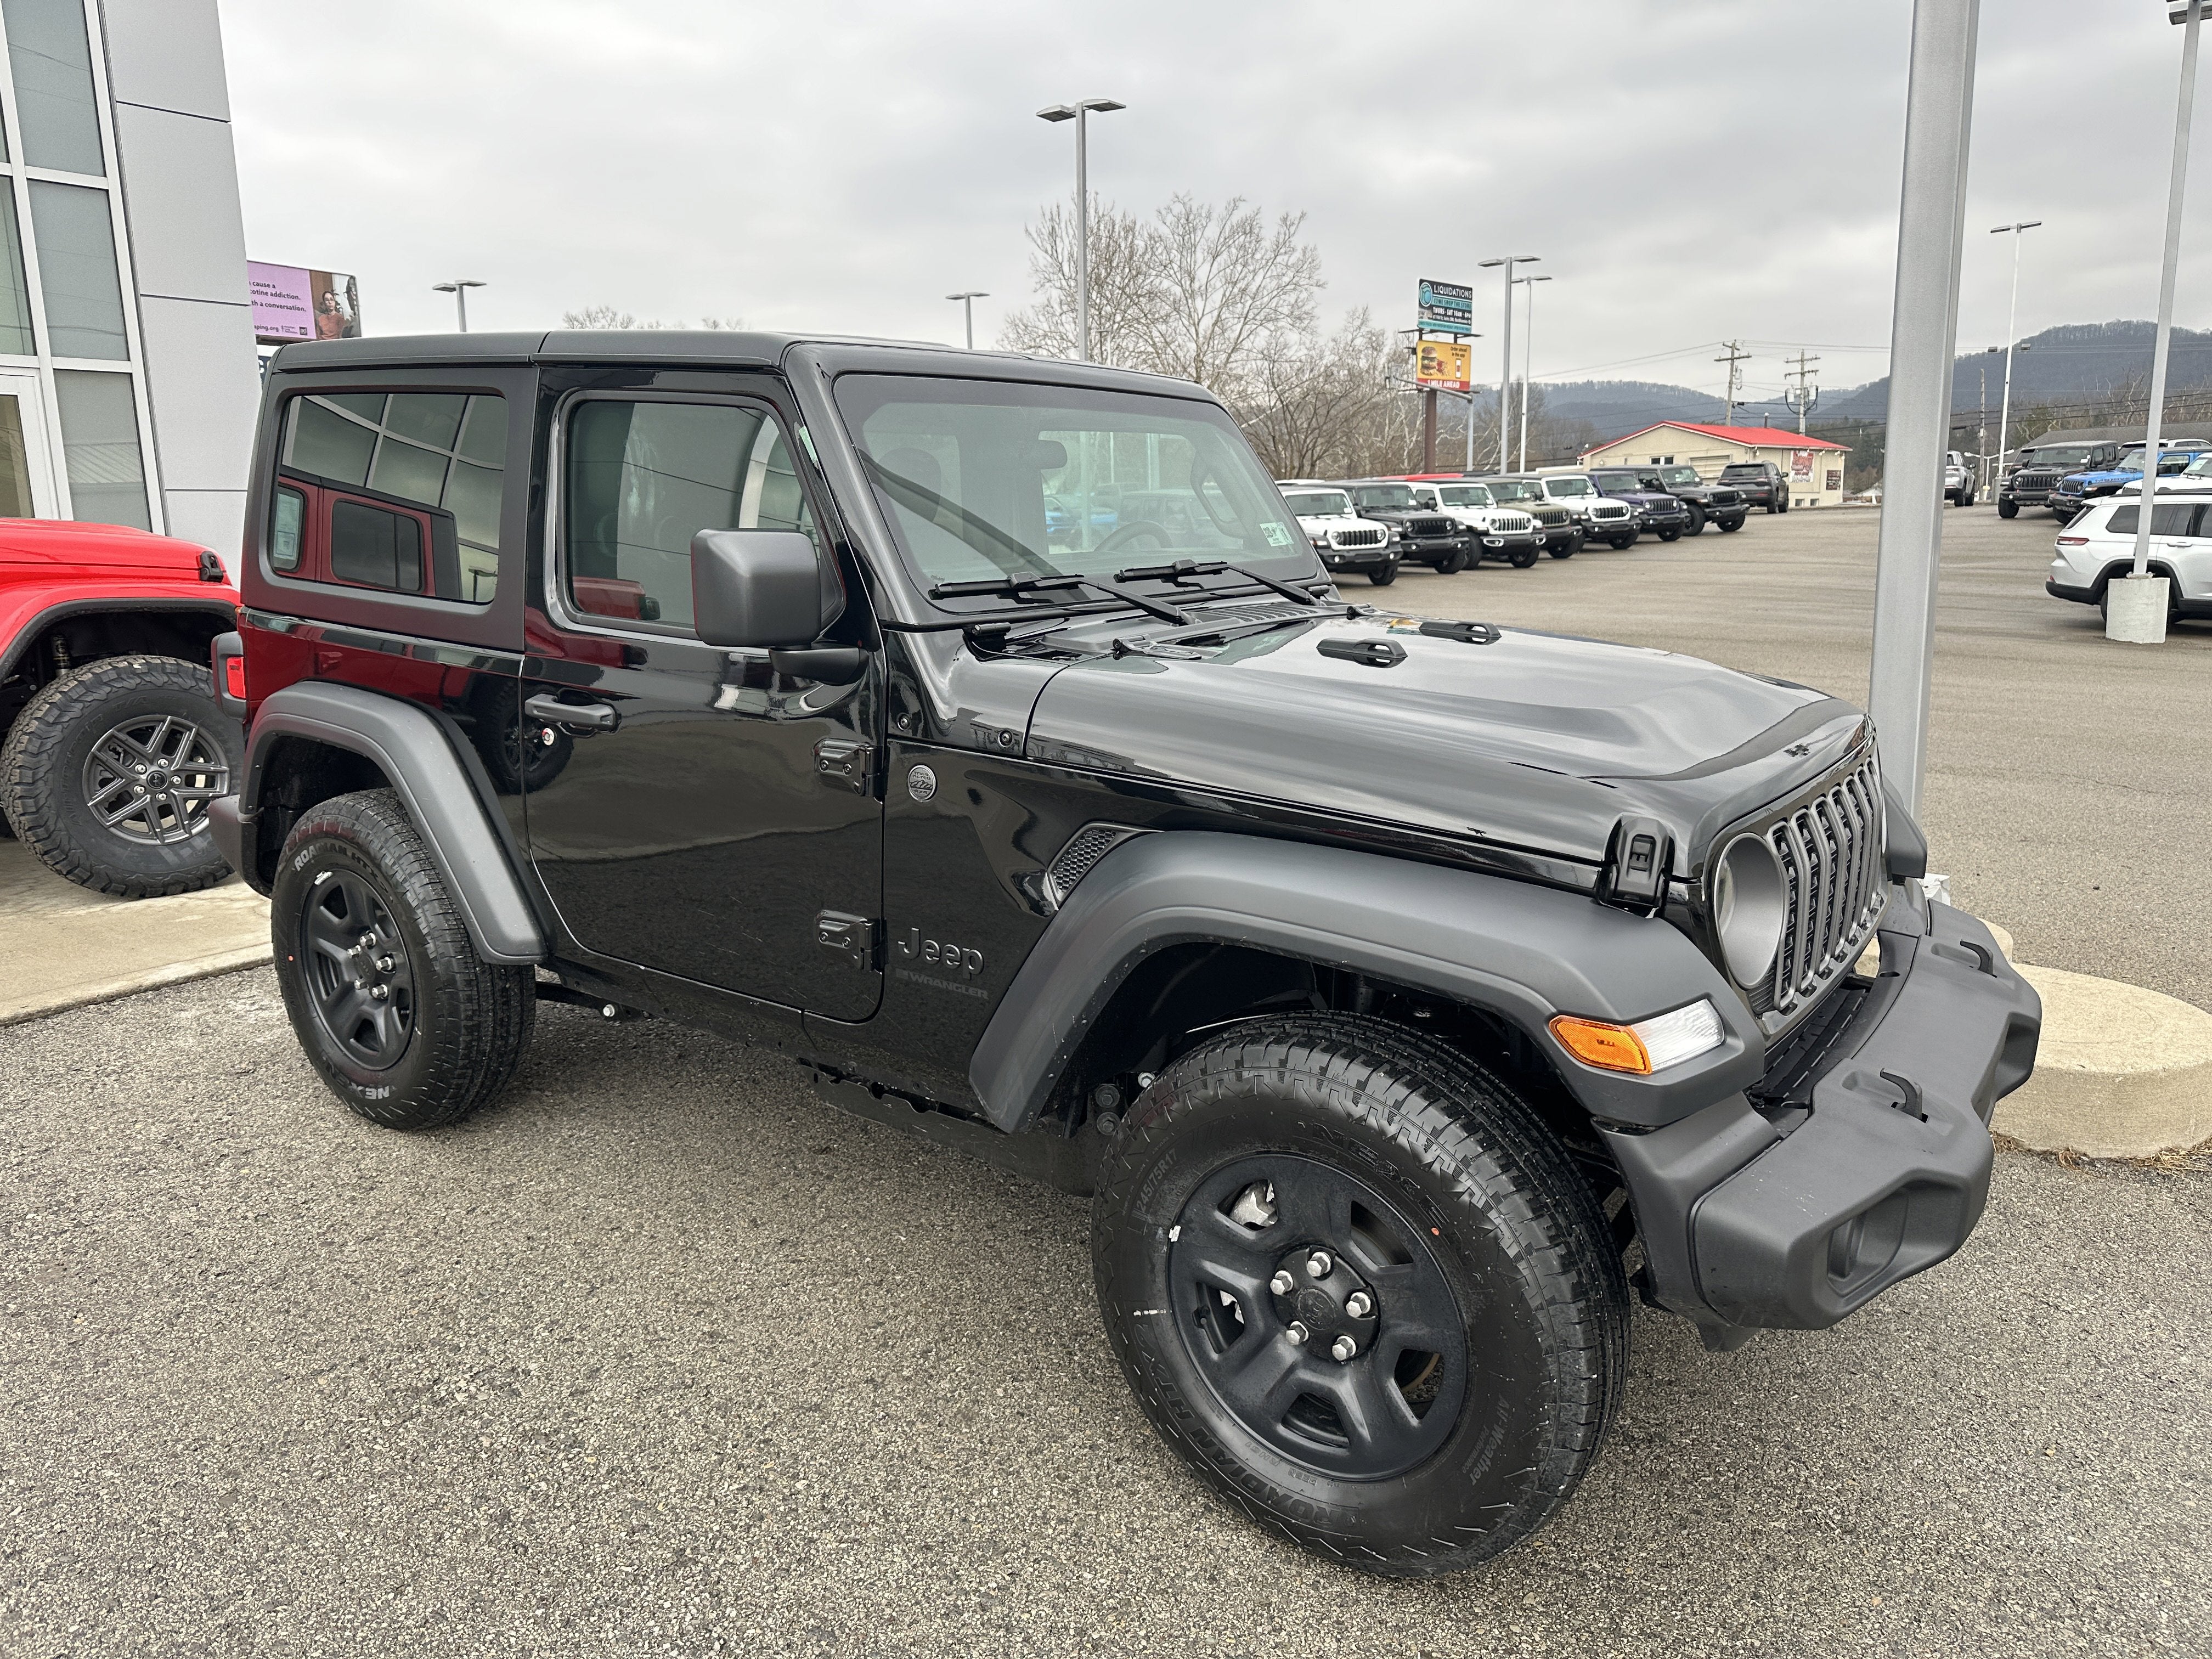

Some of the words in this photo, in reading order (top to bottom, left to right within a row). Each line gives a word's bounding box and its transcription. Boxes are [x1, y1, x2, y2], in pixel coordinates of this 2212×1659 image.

[270, 291, 301, 300] addiction.
[1434, 285, 1471, 299] LIQUIDATIONS
[264, 302, 307, 312] conversation.
[294, 843, 348, 871] ROADIAN
[898, 927, 985, 980] Jeep
[907, 971, 989, 1000] WRANGLER
[1136, 1147, 1177, 1213] 245/75R17
[1469, 1393, 1510, 1486] All-Weather
[1188, 1426, 1340, 1527] ROADIAN
